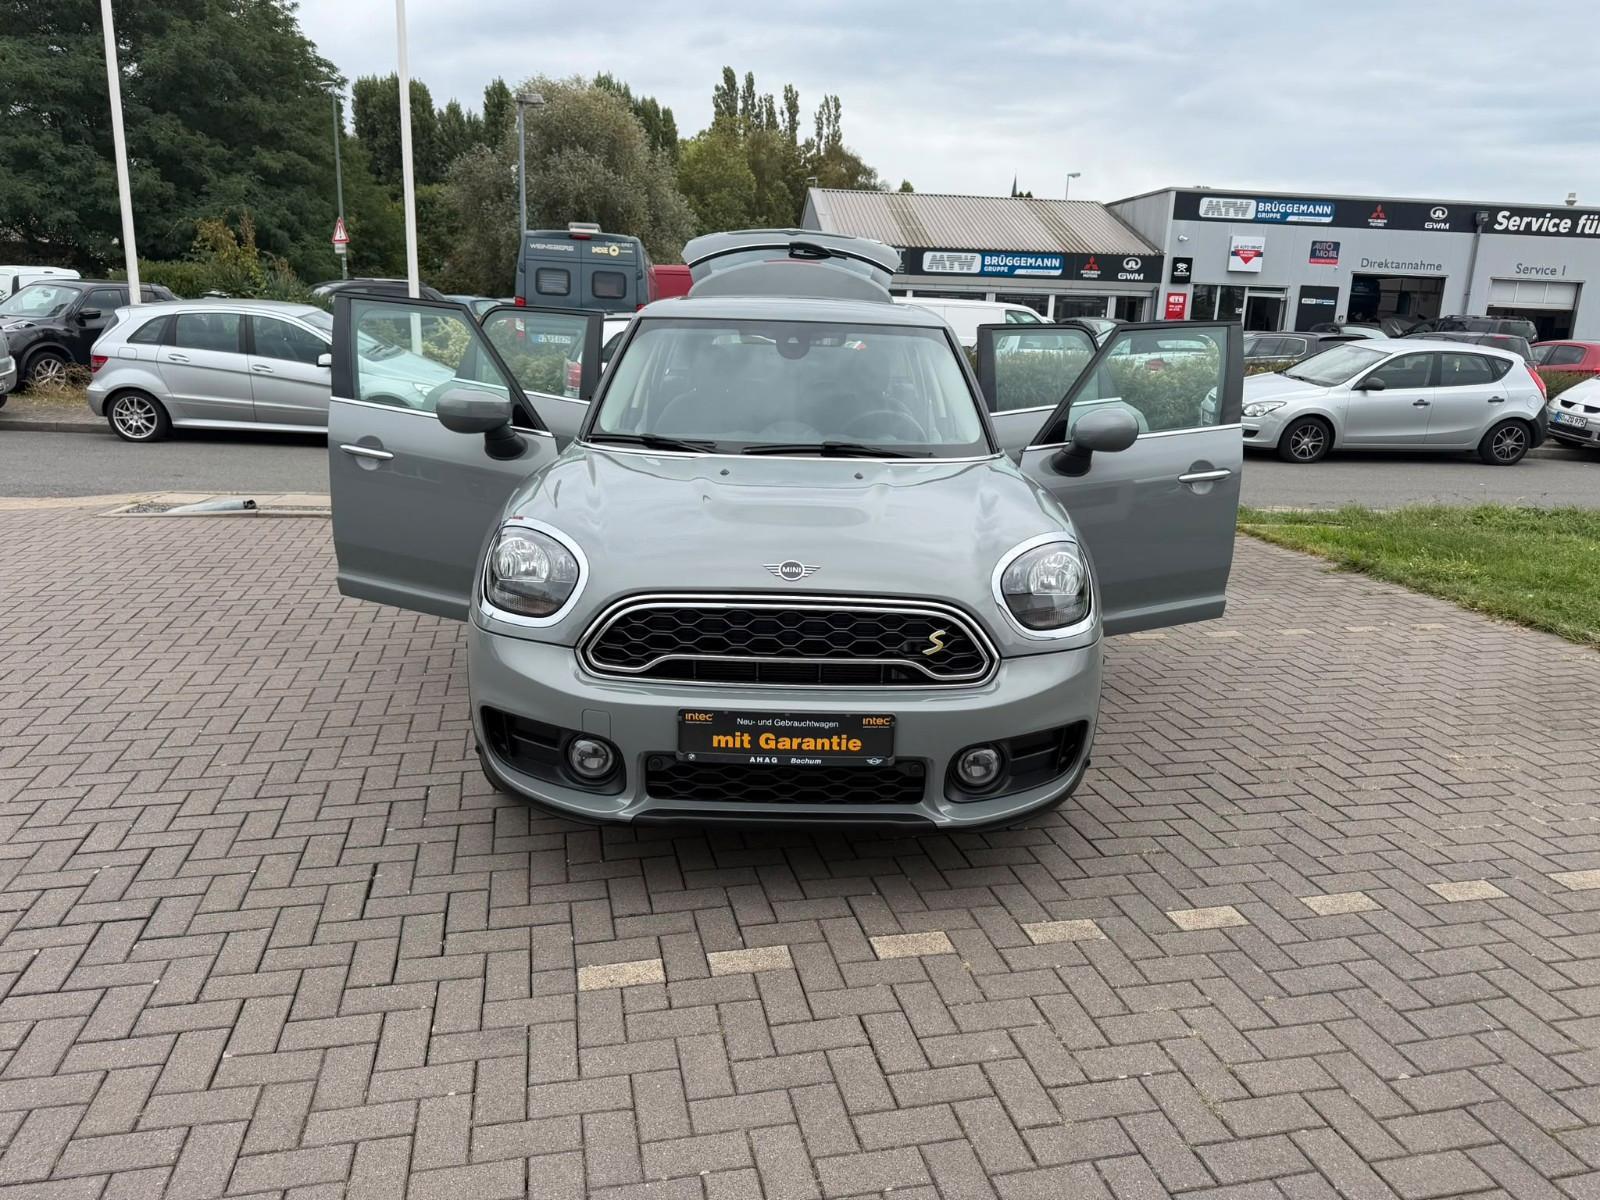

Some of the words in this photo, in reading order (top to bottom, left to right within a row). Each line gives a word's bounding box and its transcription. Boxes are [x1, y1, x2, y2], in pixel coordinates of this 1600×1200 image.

[1203, 200, 1252, 217] MTW
[1257, 201, 1331, 214] BRÜGGEMANN
[1424, 222, 1450, 230] GWM
[1493, 210, 1572, 233] Service
[926, 254, 977, 271] MTW
[984, 255, 1060, 267] BRÜGGEMANN
[1360, 257, 1442, 271] Direktannahme
[1515, 262, 1557, 276] Service
[1117, 272, 1144, 280] GWM
[922, 630, 946, 655] S
[685, 712, 713, 721] intec
[737, 717, 756, 726] Neu-
[757, 718, 772, 726] und
[774, 718, 839, 729] Gebrauchtwagen
[863, 717, 890, 725] intec
[712, 731, 751, 749] mit
[759, 732, 862, 751] Garantie
[790, 757, 822, 765] Bochum
